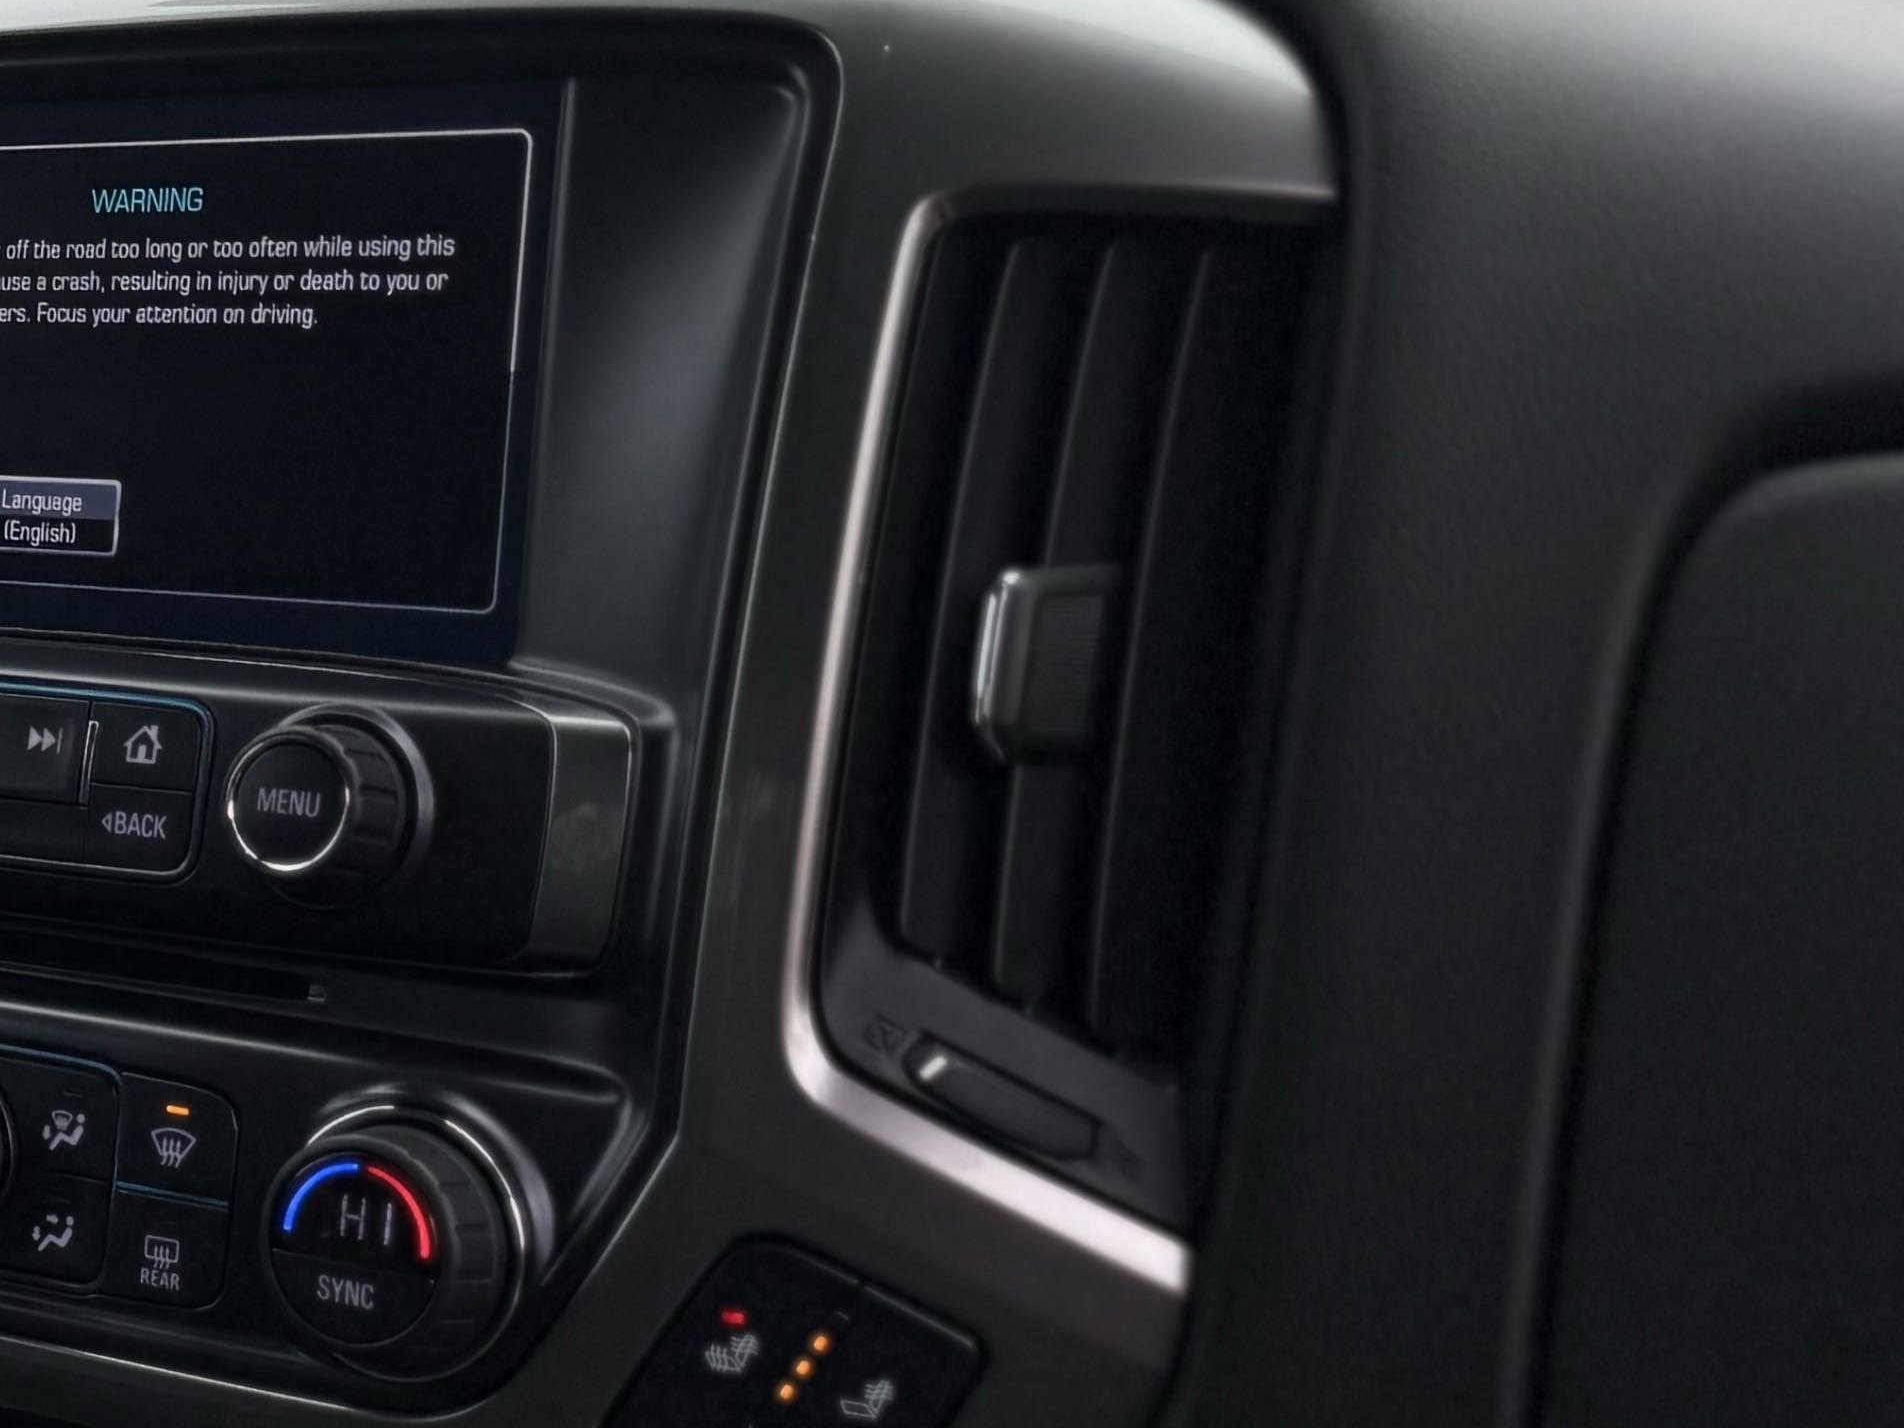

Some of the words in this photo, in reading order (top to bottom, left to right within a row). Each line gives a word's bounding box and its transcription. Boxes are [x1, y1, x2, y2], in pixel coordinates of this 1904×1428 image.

[92, 187, 203, 213] WARNING
[7, 239, 29, 259] off
[34, 240, 60, 259] the
[66, 238, 106, 258] road
[112, 242, 139, 258] too
[146, 238, 182, 263] long
[188, 242, 208, 258] or
[214, 240, 243, 257] too
[249, 236, 297, 257] often
[304, 235, 352, 257] while
[359, 235, 411, 261] using
[417, 234, 455, 256] this
[37, 276, 46, 290] a
[53, 270, 104, 293] crash,
[112, 270, 190, 296] resulting
[197, 271, 211, 290] in
[218, 271, 268, 295] injury
[274, 275, 294, 290] or
[300, 269, 353, 290] death
[360, 272, 380, 290] to
[387, 274, 419, 295] you
[426, 274, 448, 290] or
[37, 302, 86, 322] Focus
[92, 308, 130, 327] your
[136, 304, 217, 323] attention
[224, 308, 244, 324] on
[251, 302, 317, 329] driving.
[2, 489, 82, 516] Language
[3, 521, 75, 547] (English)
[257, 788, 320, 817] MENU
[114, 811, 166, 840] BACK
[141, 1266, 179, 1290] REAR
[317, 1275, 373, 1309] SYNC
